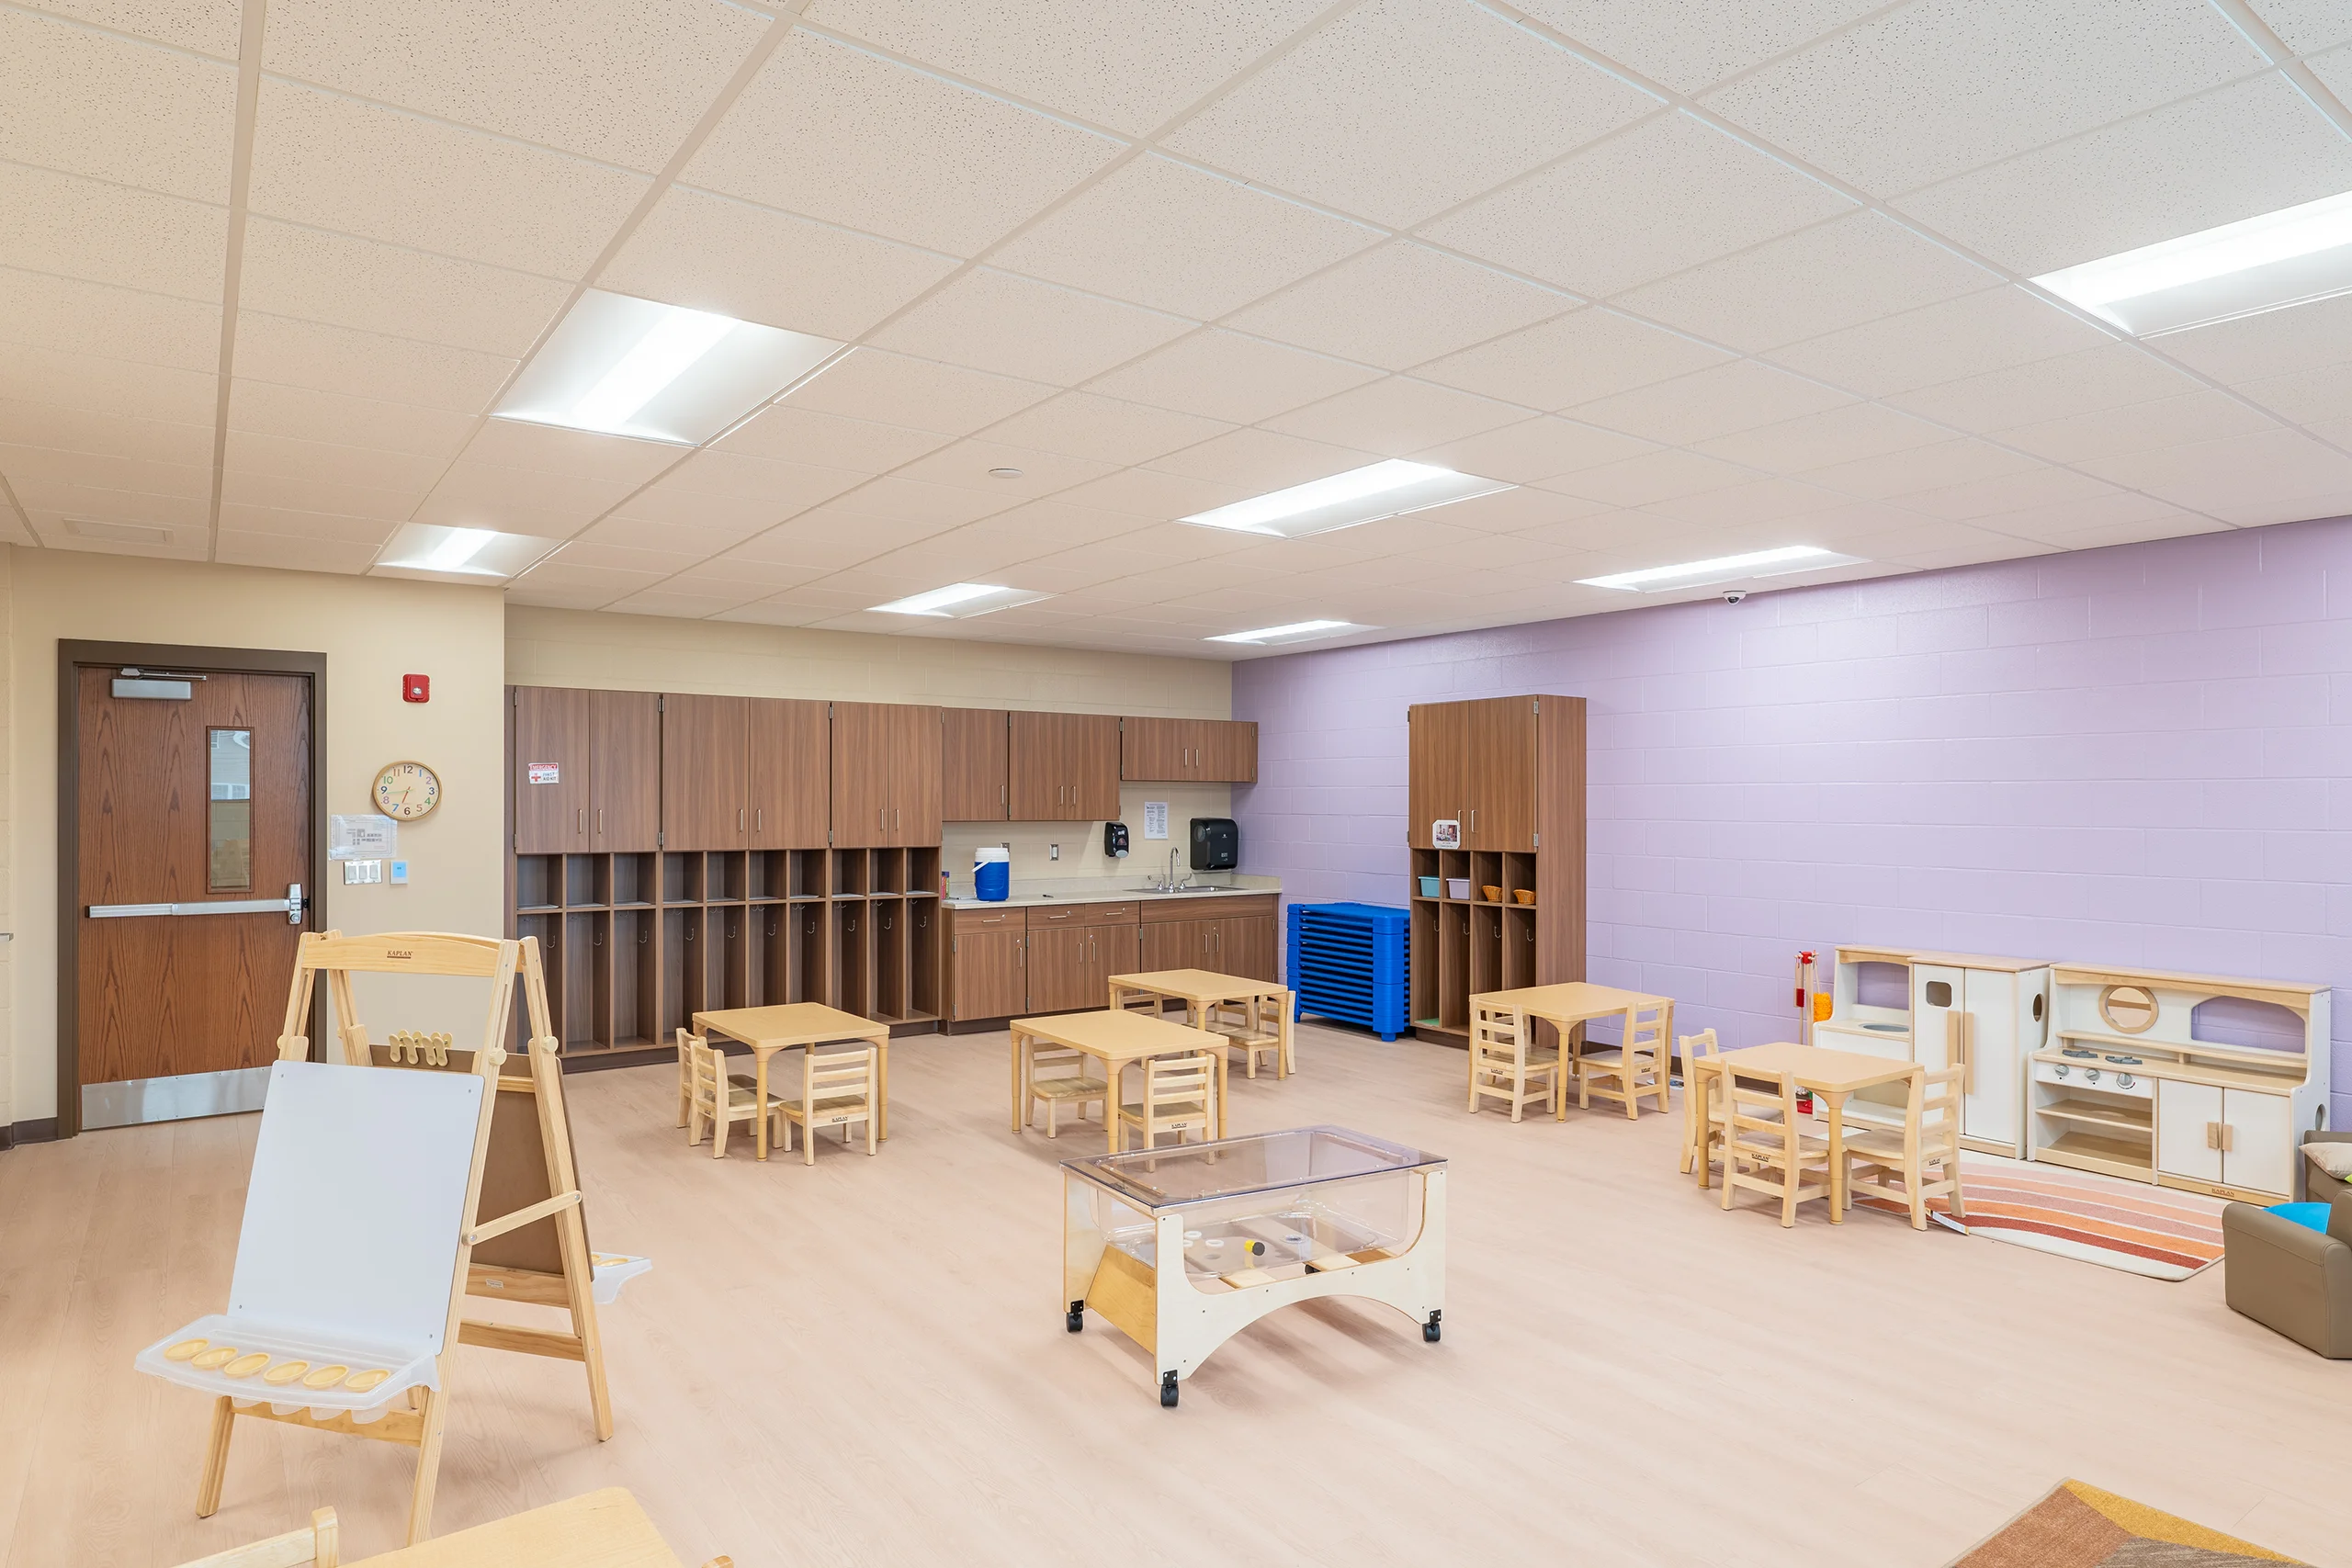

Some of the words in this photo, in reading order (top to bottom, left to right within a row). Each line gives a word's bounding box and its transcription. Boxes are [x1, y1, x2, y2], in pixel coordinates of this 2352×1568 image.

[393, 768, 400, 777] 11
[403, 765, 413, 773] 12
[383, 776, 393, 784] 10
[425, 776, 432, 784] 2
[380, 785, 388, 795] 9
[428, 786, 435, 795] 3
[382, 795, 390, 805] 8
[424, 796, 431, 805] 4
[391, 803, 400, 812] 7
[404, 807, 411, 815] 6
[416, 804, 423, 812] 5
[1751, 1153, 1770, 1161] KAPLAN
[2211, 1188, 2234, 1196] KAPLAN
